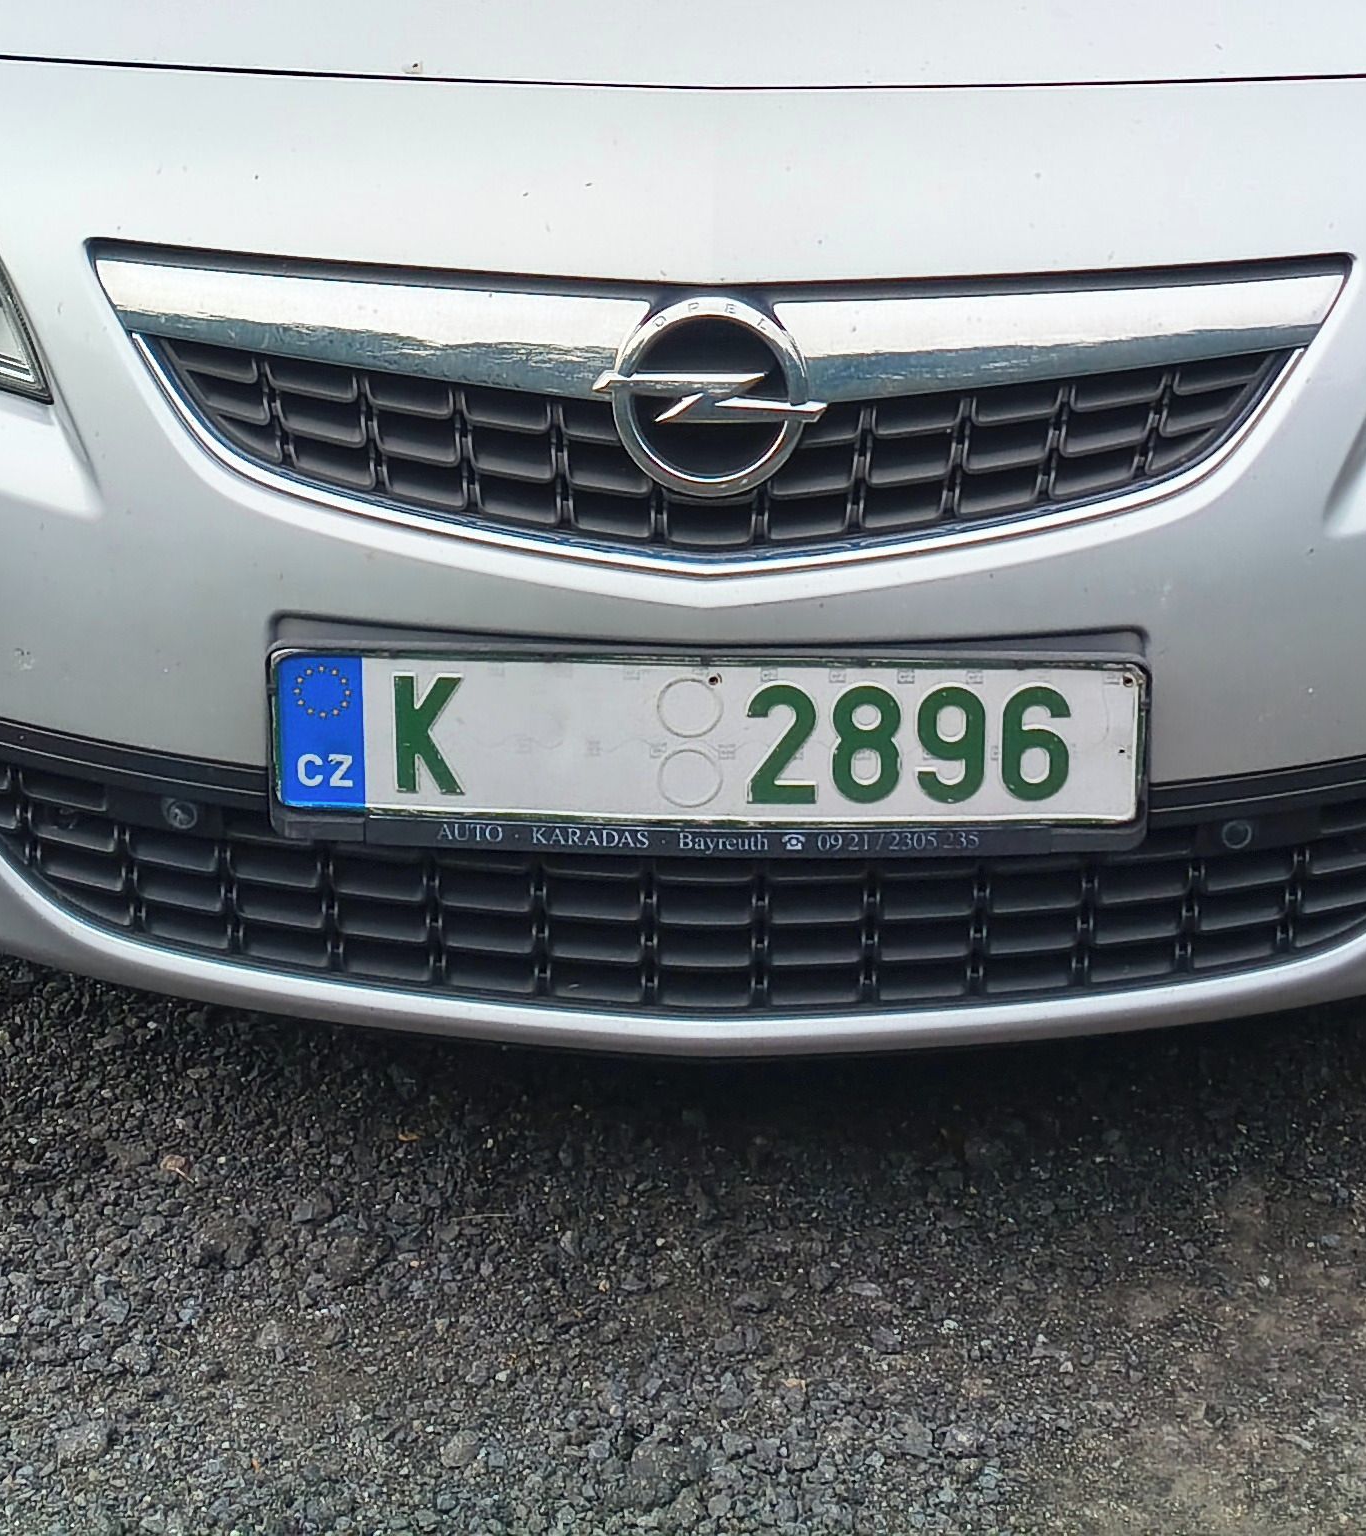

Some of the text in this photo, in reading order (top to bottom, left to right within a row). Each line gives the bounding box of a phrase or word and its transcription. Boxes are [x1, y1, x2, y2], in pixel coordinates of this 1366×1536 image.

[653, 302, 767, 331] OPEL
[297, 672, 1073, 805] CZ K 2896
[436, 823, 503, 842] AUTO
[531, 826, 650, 849] KARADAS
[678, 832, 769, 855] Bayreuth
